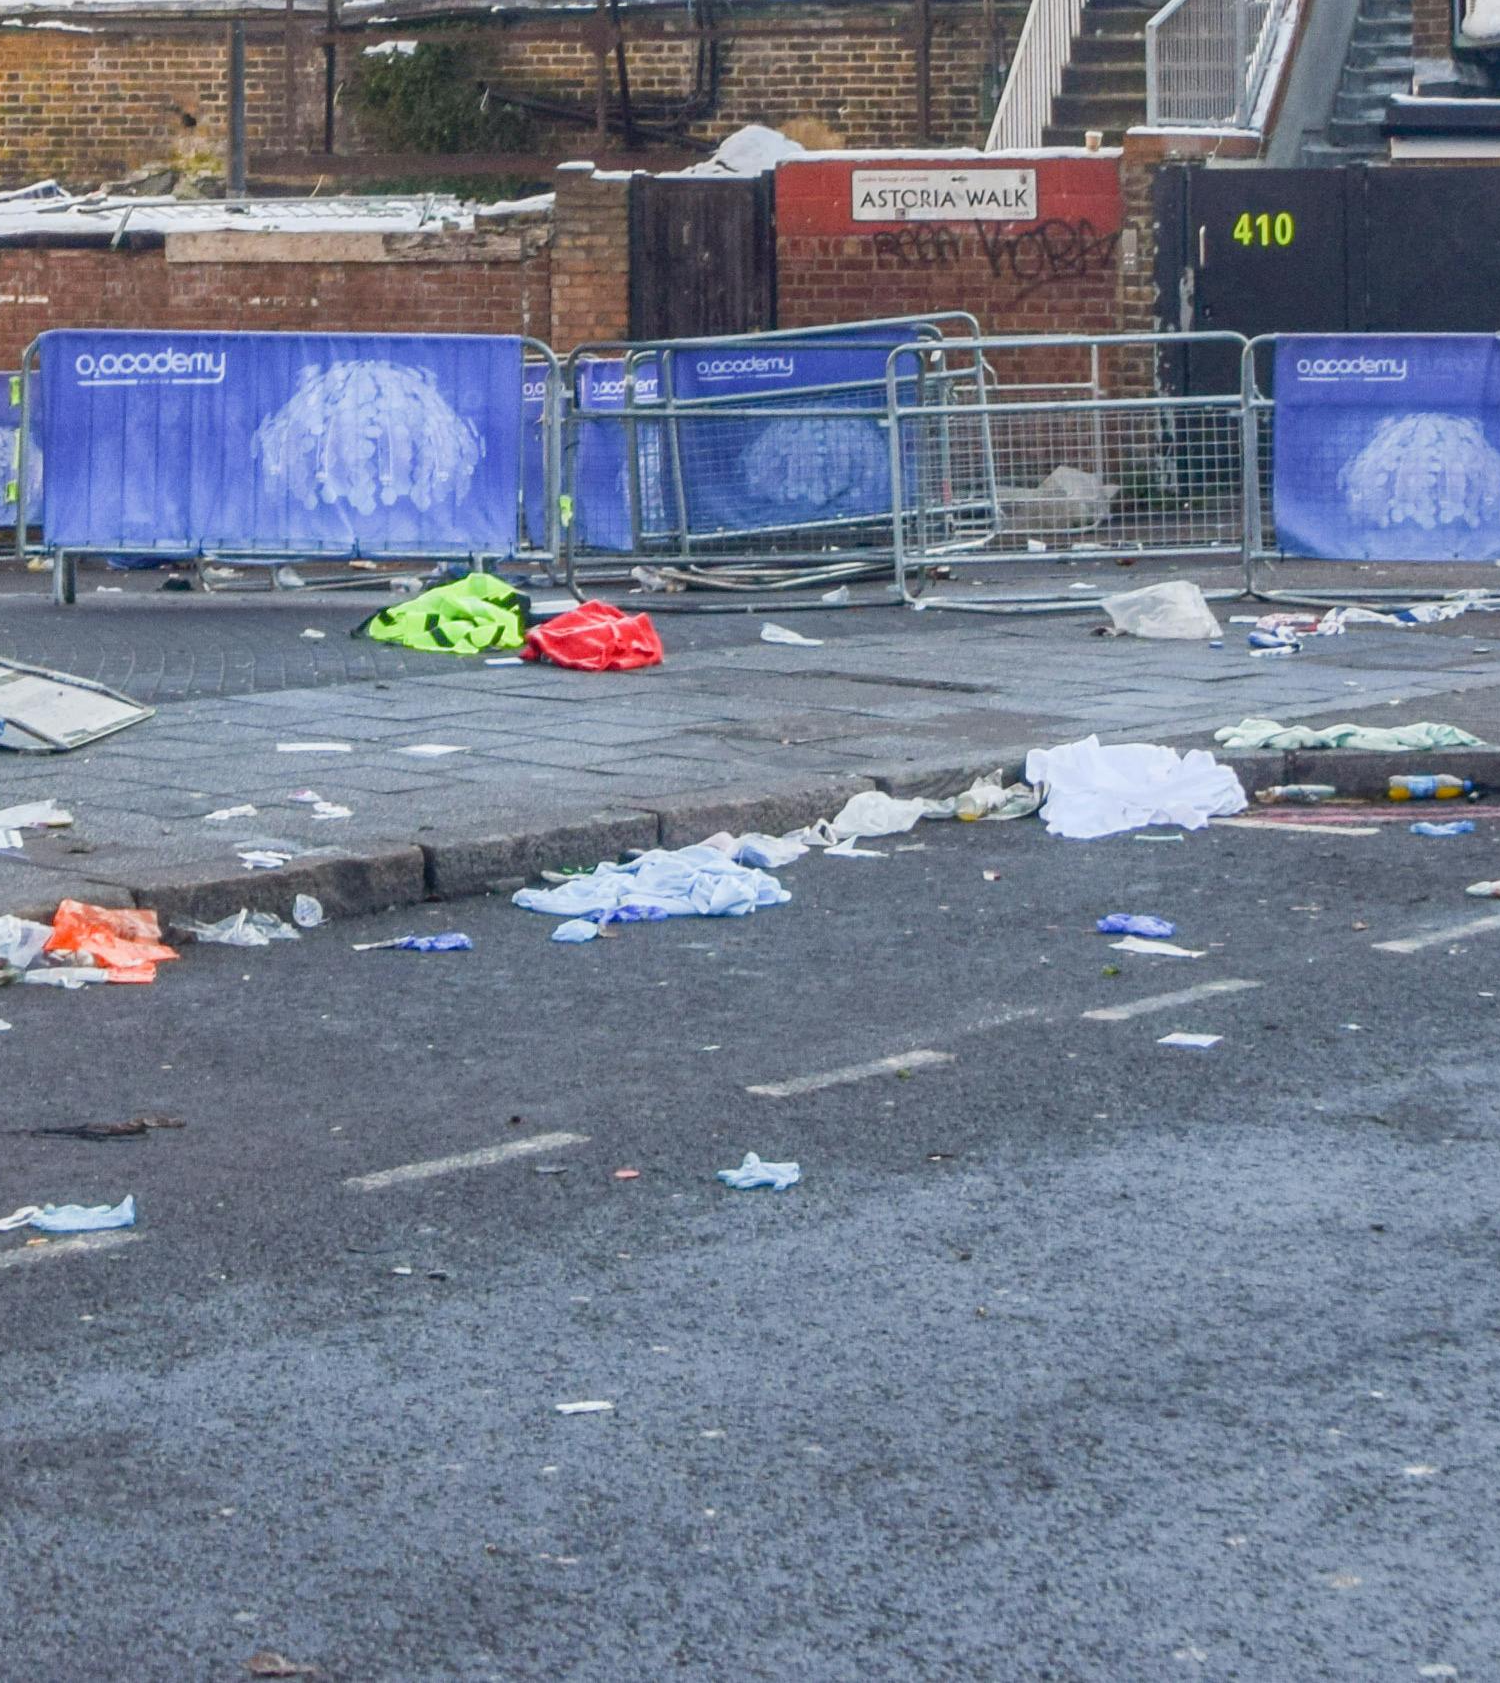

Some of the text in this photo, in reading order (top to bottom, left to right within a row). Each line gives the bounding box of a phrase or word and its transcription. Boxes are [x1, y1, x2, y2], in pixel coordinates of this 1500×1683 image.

[860, 189, 1028, 208] ASTORIA WALK
[1233, 212, 1294, 247] 410
